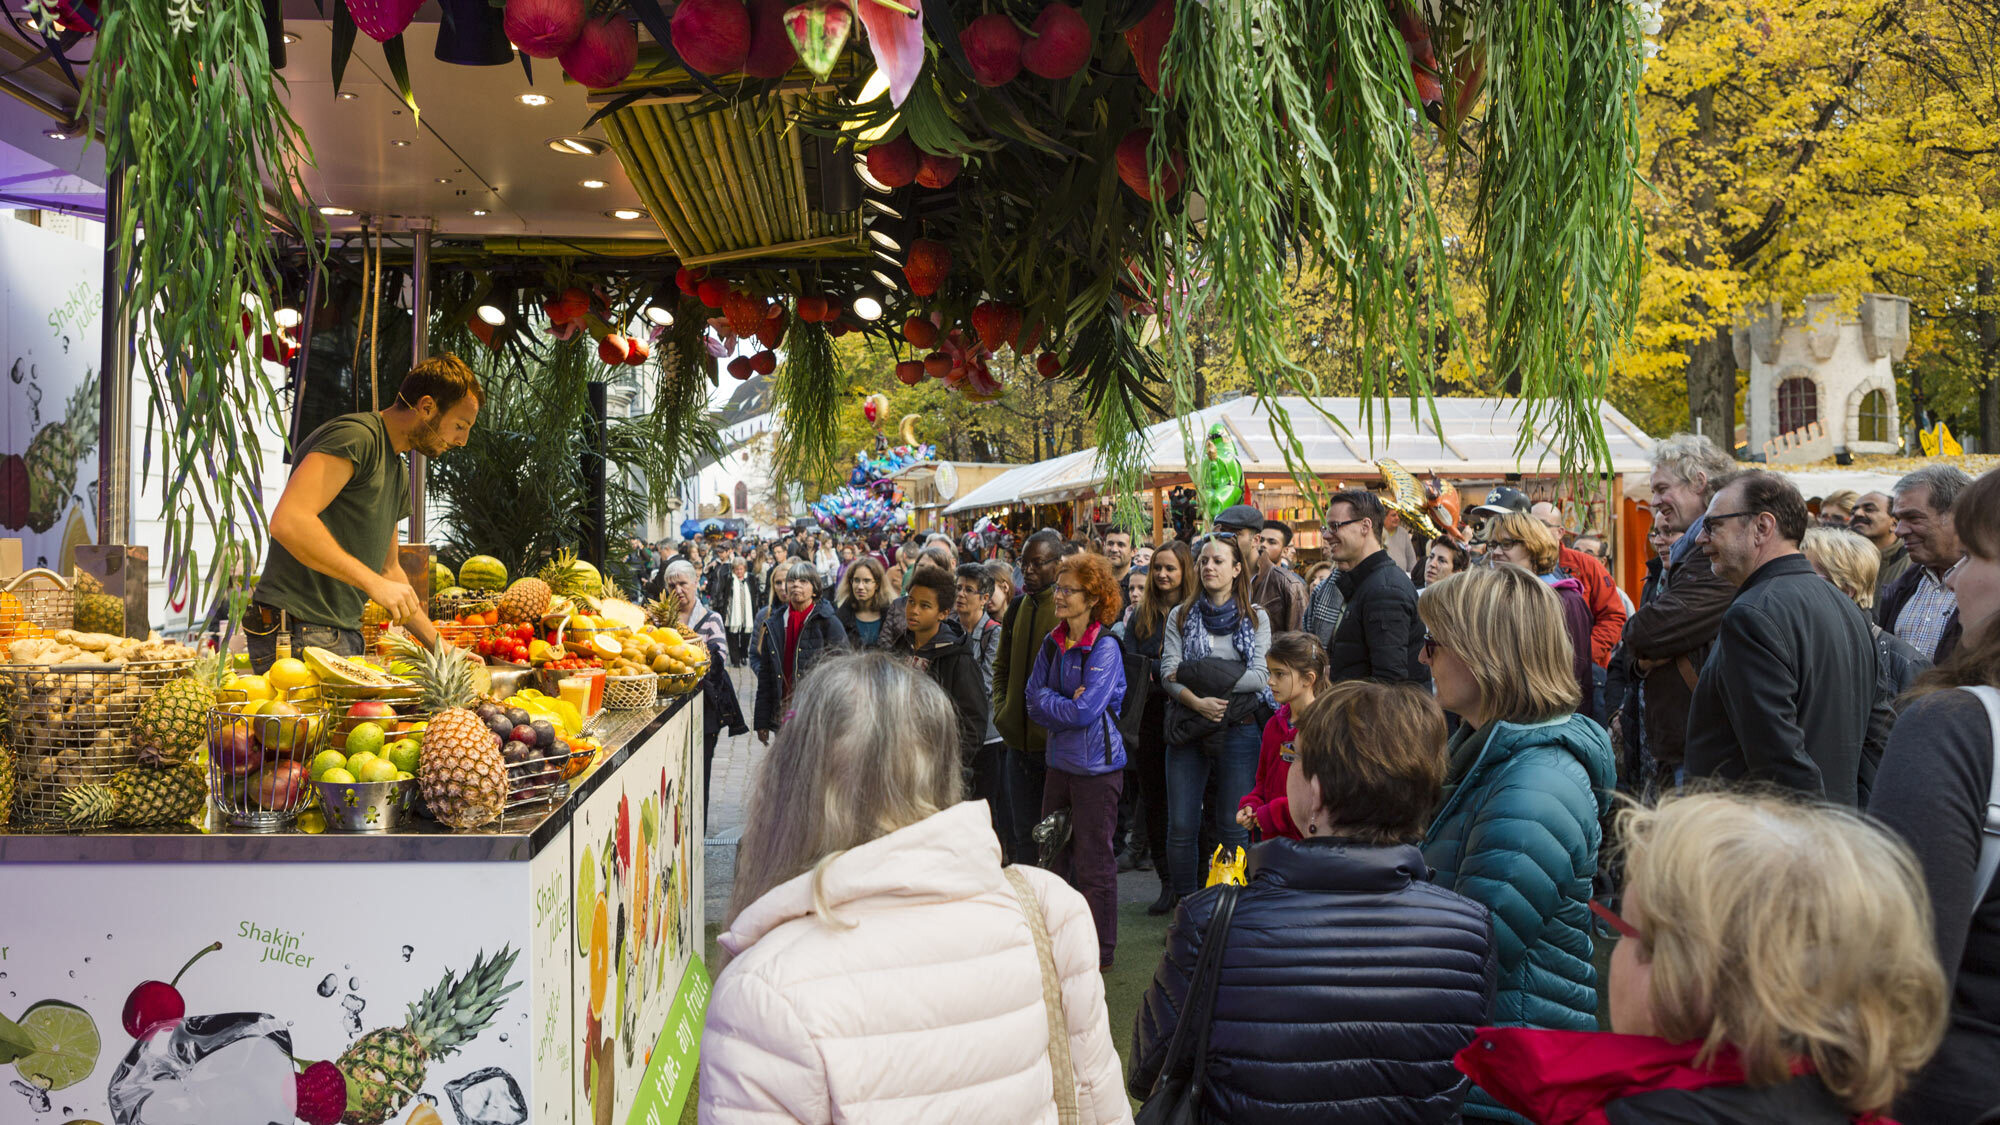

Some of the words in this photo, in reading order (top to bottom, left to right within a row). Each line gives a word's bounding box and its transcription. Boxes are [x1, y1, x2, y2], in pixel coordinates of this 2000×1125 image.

[76, 284, 103, 342] juice
[237, 920, 304, 950] Shakin'
[260, 945, 315, 968] juicer
[676, 1013, 695, 1054] any
